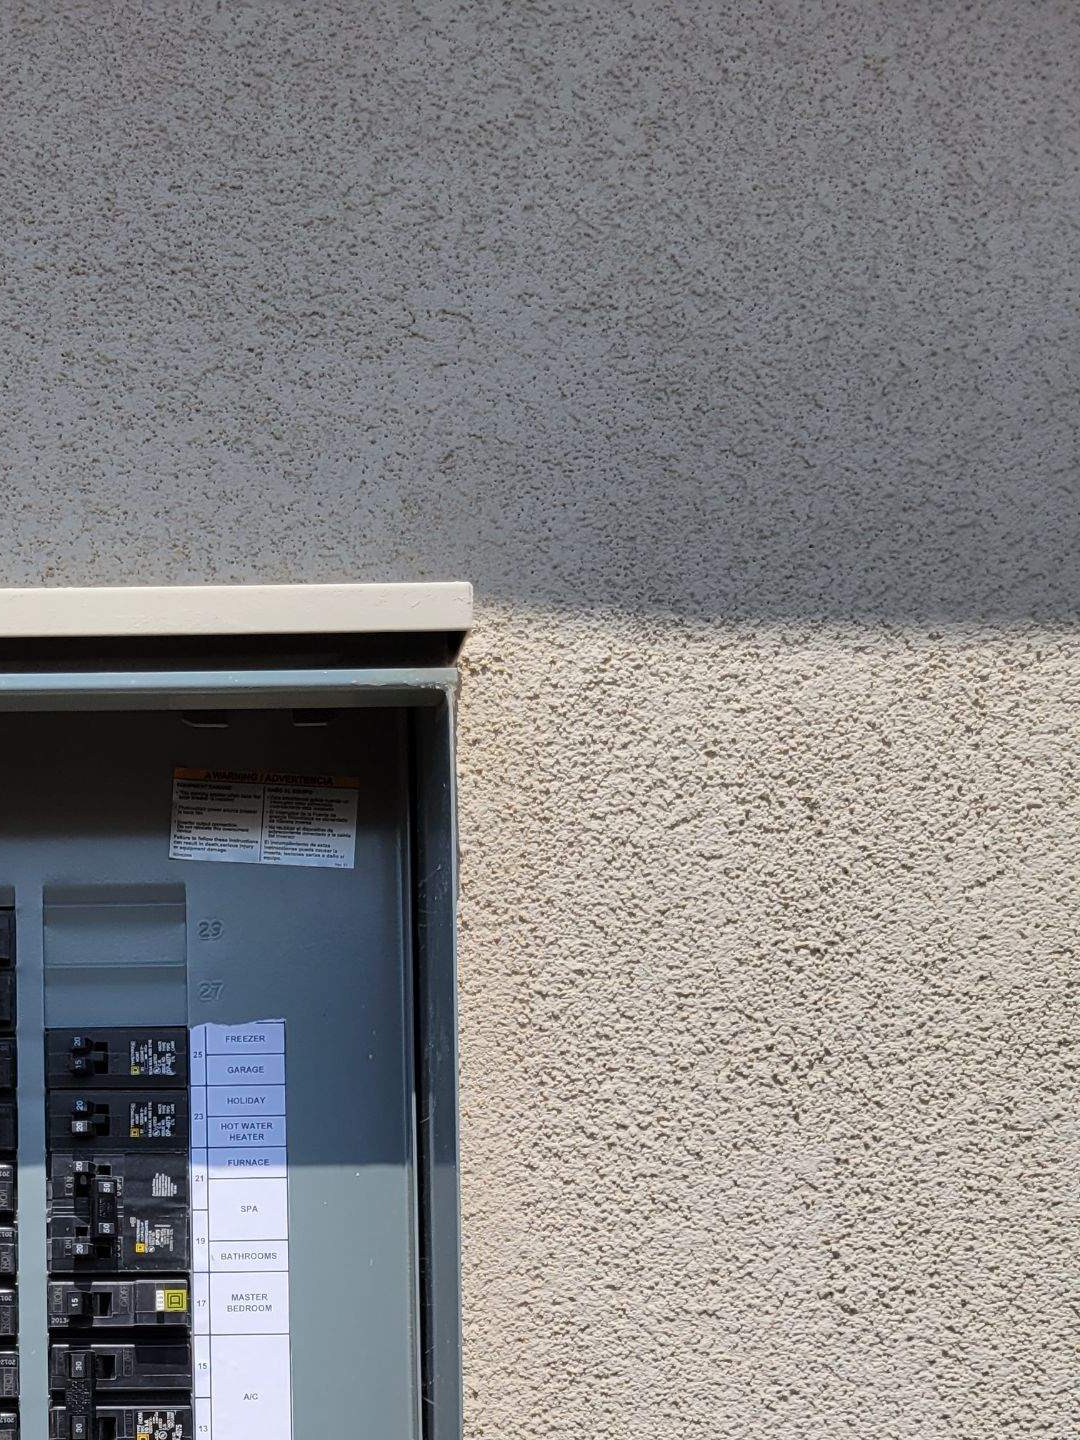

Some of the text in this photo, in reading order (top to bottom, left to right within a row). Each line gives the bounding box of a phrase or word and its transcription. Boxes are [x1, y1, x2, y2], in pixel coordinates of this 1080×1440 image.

[226, 1035, 265, 1043] FREEZER
[227, 1066, 264, 1074] GARAGE
[240, 1122, 273, 1130] WATER
[229, 1133, 264, 1141] HEATER
[221, 1252, 277, 1260] BATHROOMS
[232, 1293, 268, 1301] MASTER
